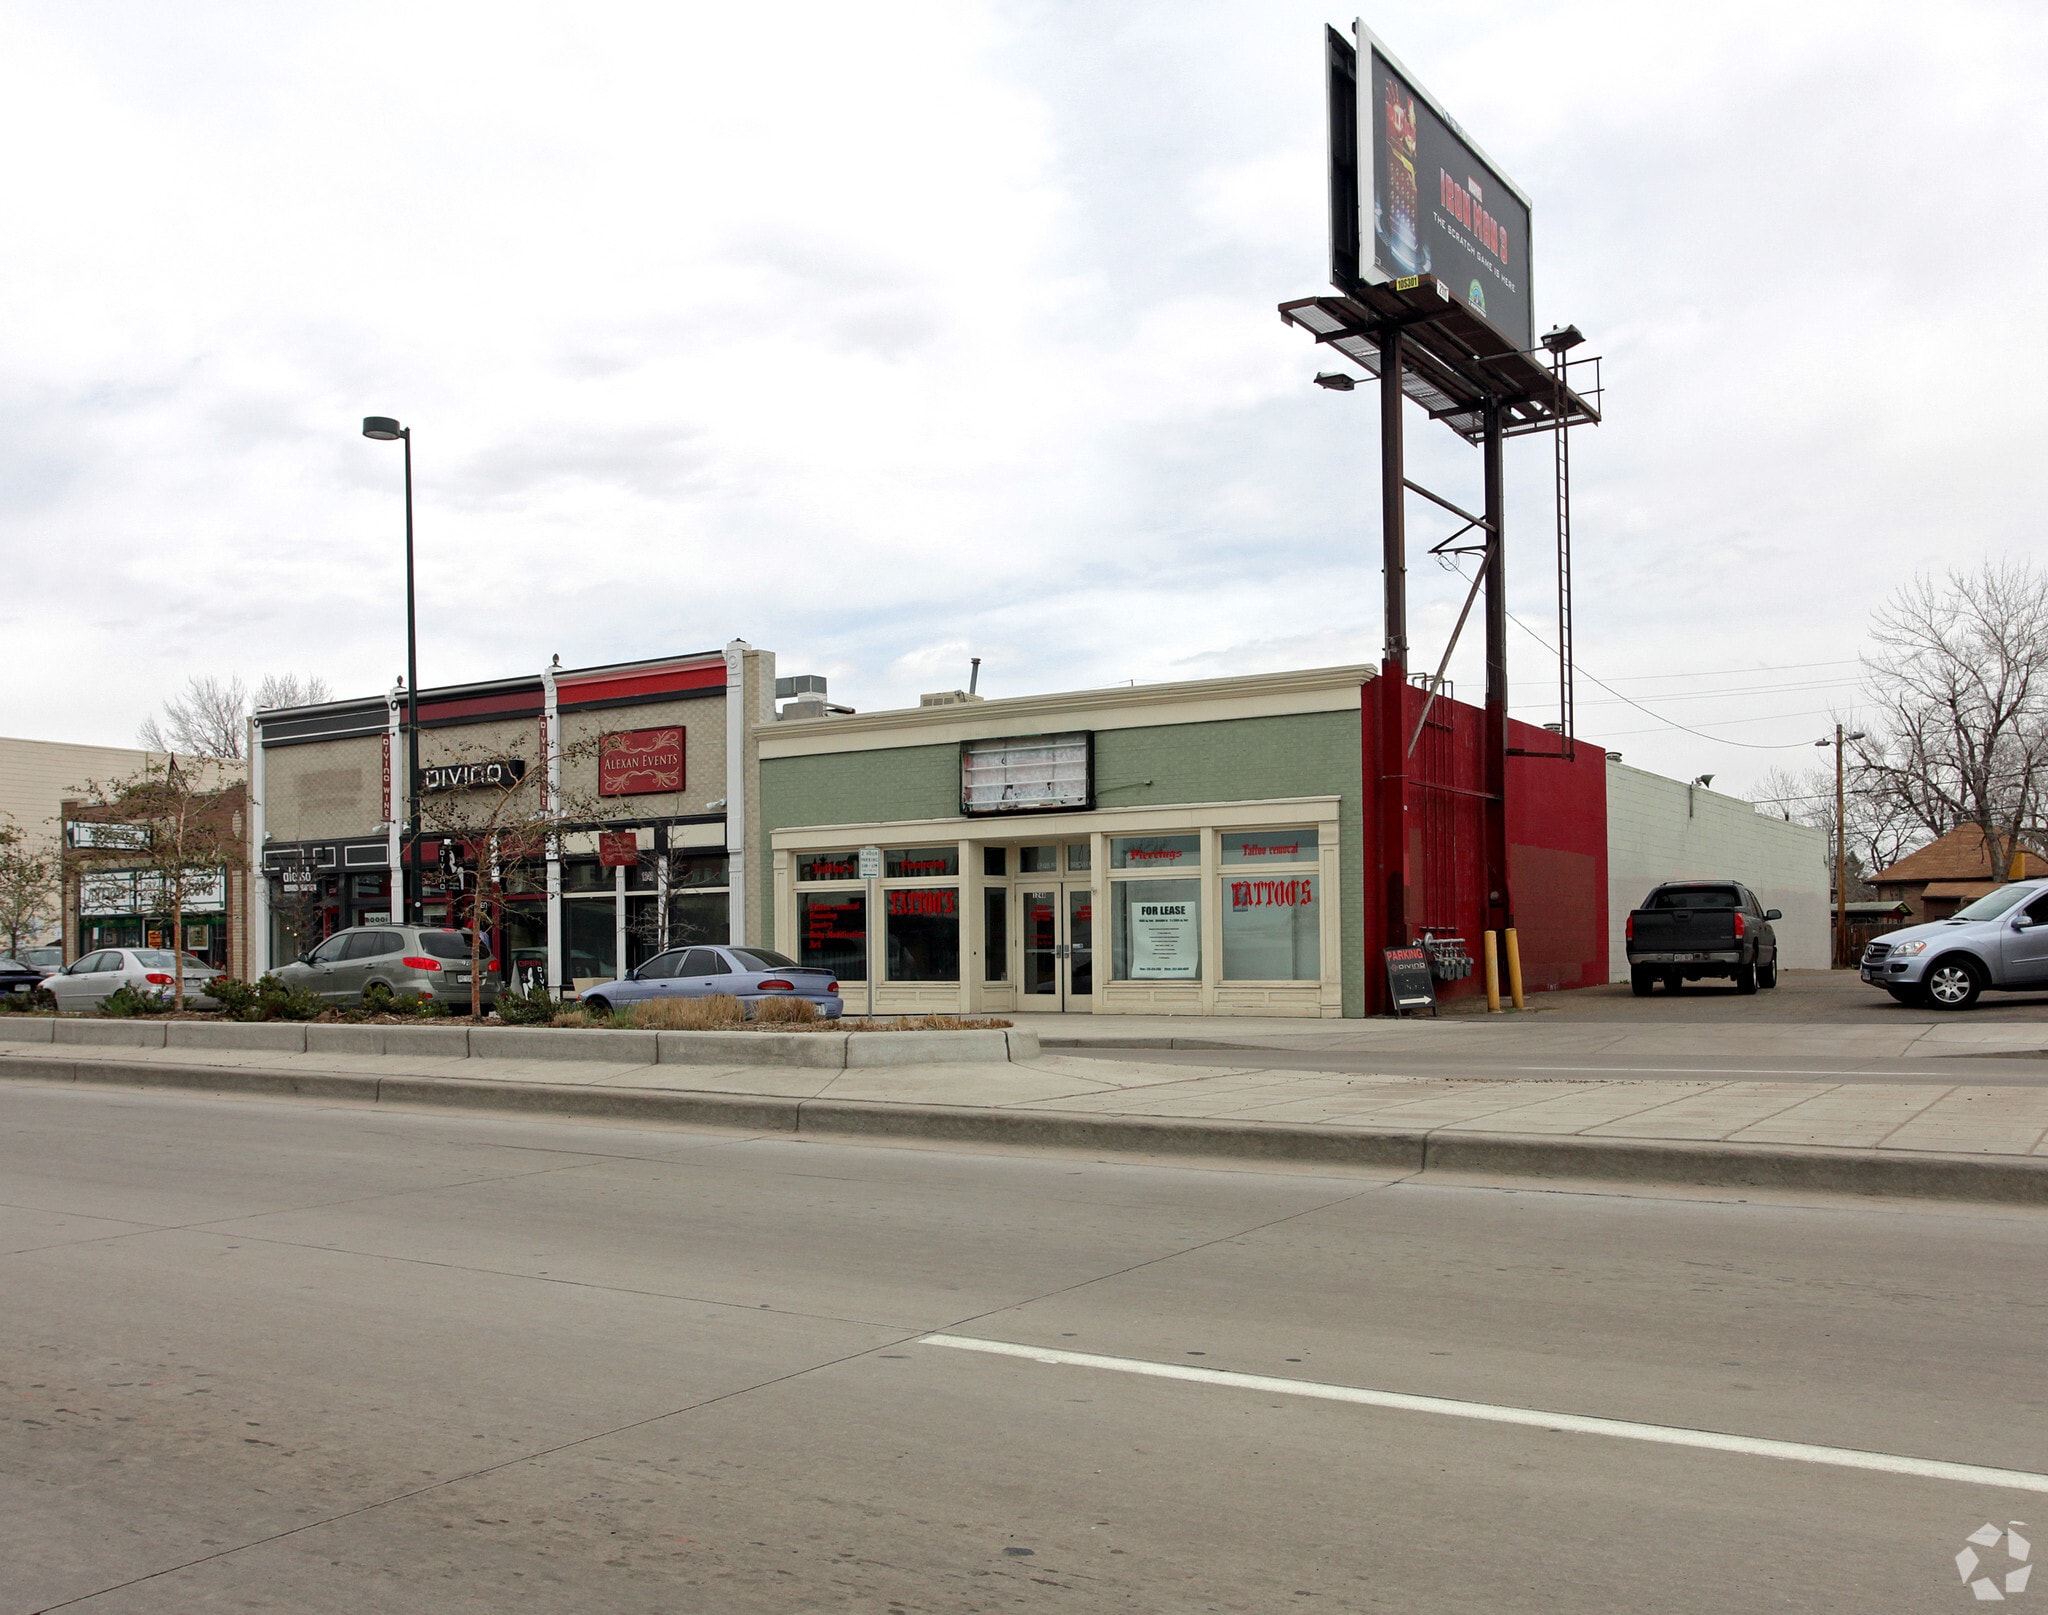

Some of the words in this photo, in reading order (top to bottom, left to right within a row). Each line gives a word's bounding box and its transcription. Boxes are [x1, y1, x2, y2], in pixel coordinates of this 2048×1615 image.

[1440, 166, 1472, 232] IRON
[1473, 199, 1498, 257] MAN
[1499, 225, 1508, 265] 3
[1432, 210, 1446, 230] THE
[1447, 224, 1475, 256] SCRATCH
[1476, 251, 1493, 273] GAME
[1494, 267, 1500, 279] IS
[1501, 273, 1516, 294] HERE
[604, 757, 639, 770] ALEXAN
[642, 753, 679, 767] EVENTS
[1129, 847, 1183, 861] Piercings
[1141, 905, 1158, 915] FOR
[1160, 905, 1186, 915] LEASE
[1386, 948, 1424, 961] PARKING
